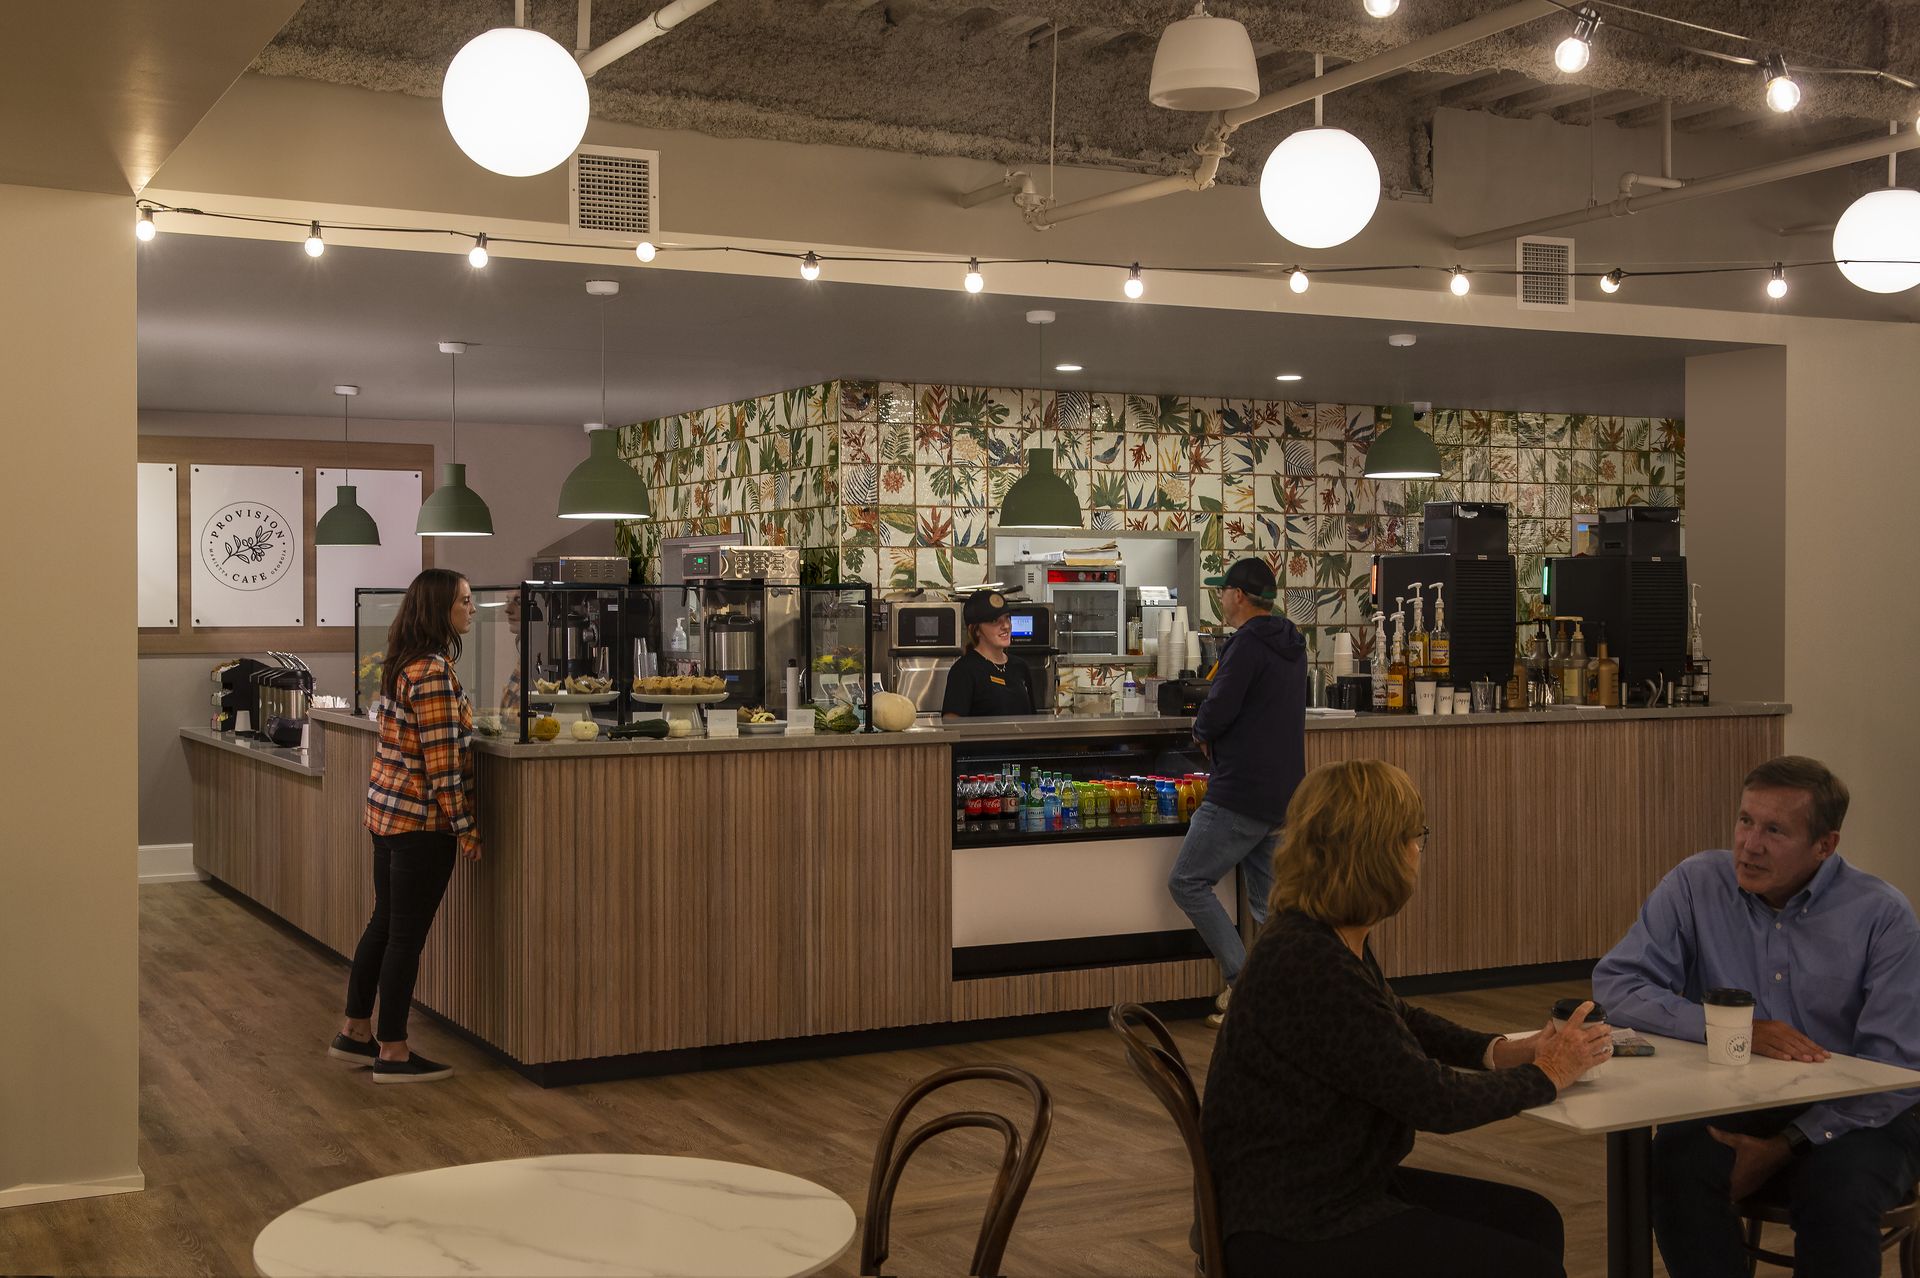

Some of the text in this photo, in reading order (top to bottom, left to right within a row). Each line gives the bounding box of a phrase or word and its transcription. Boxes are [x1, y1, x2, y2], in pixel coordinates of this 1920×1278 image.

[211, 509, 285, 539] PROVISION
[270, 549, 287, 575] GEORGIA
[232, 572, 267, 583] CAFE
